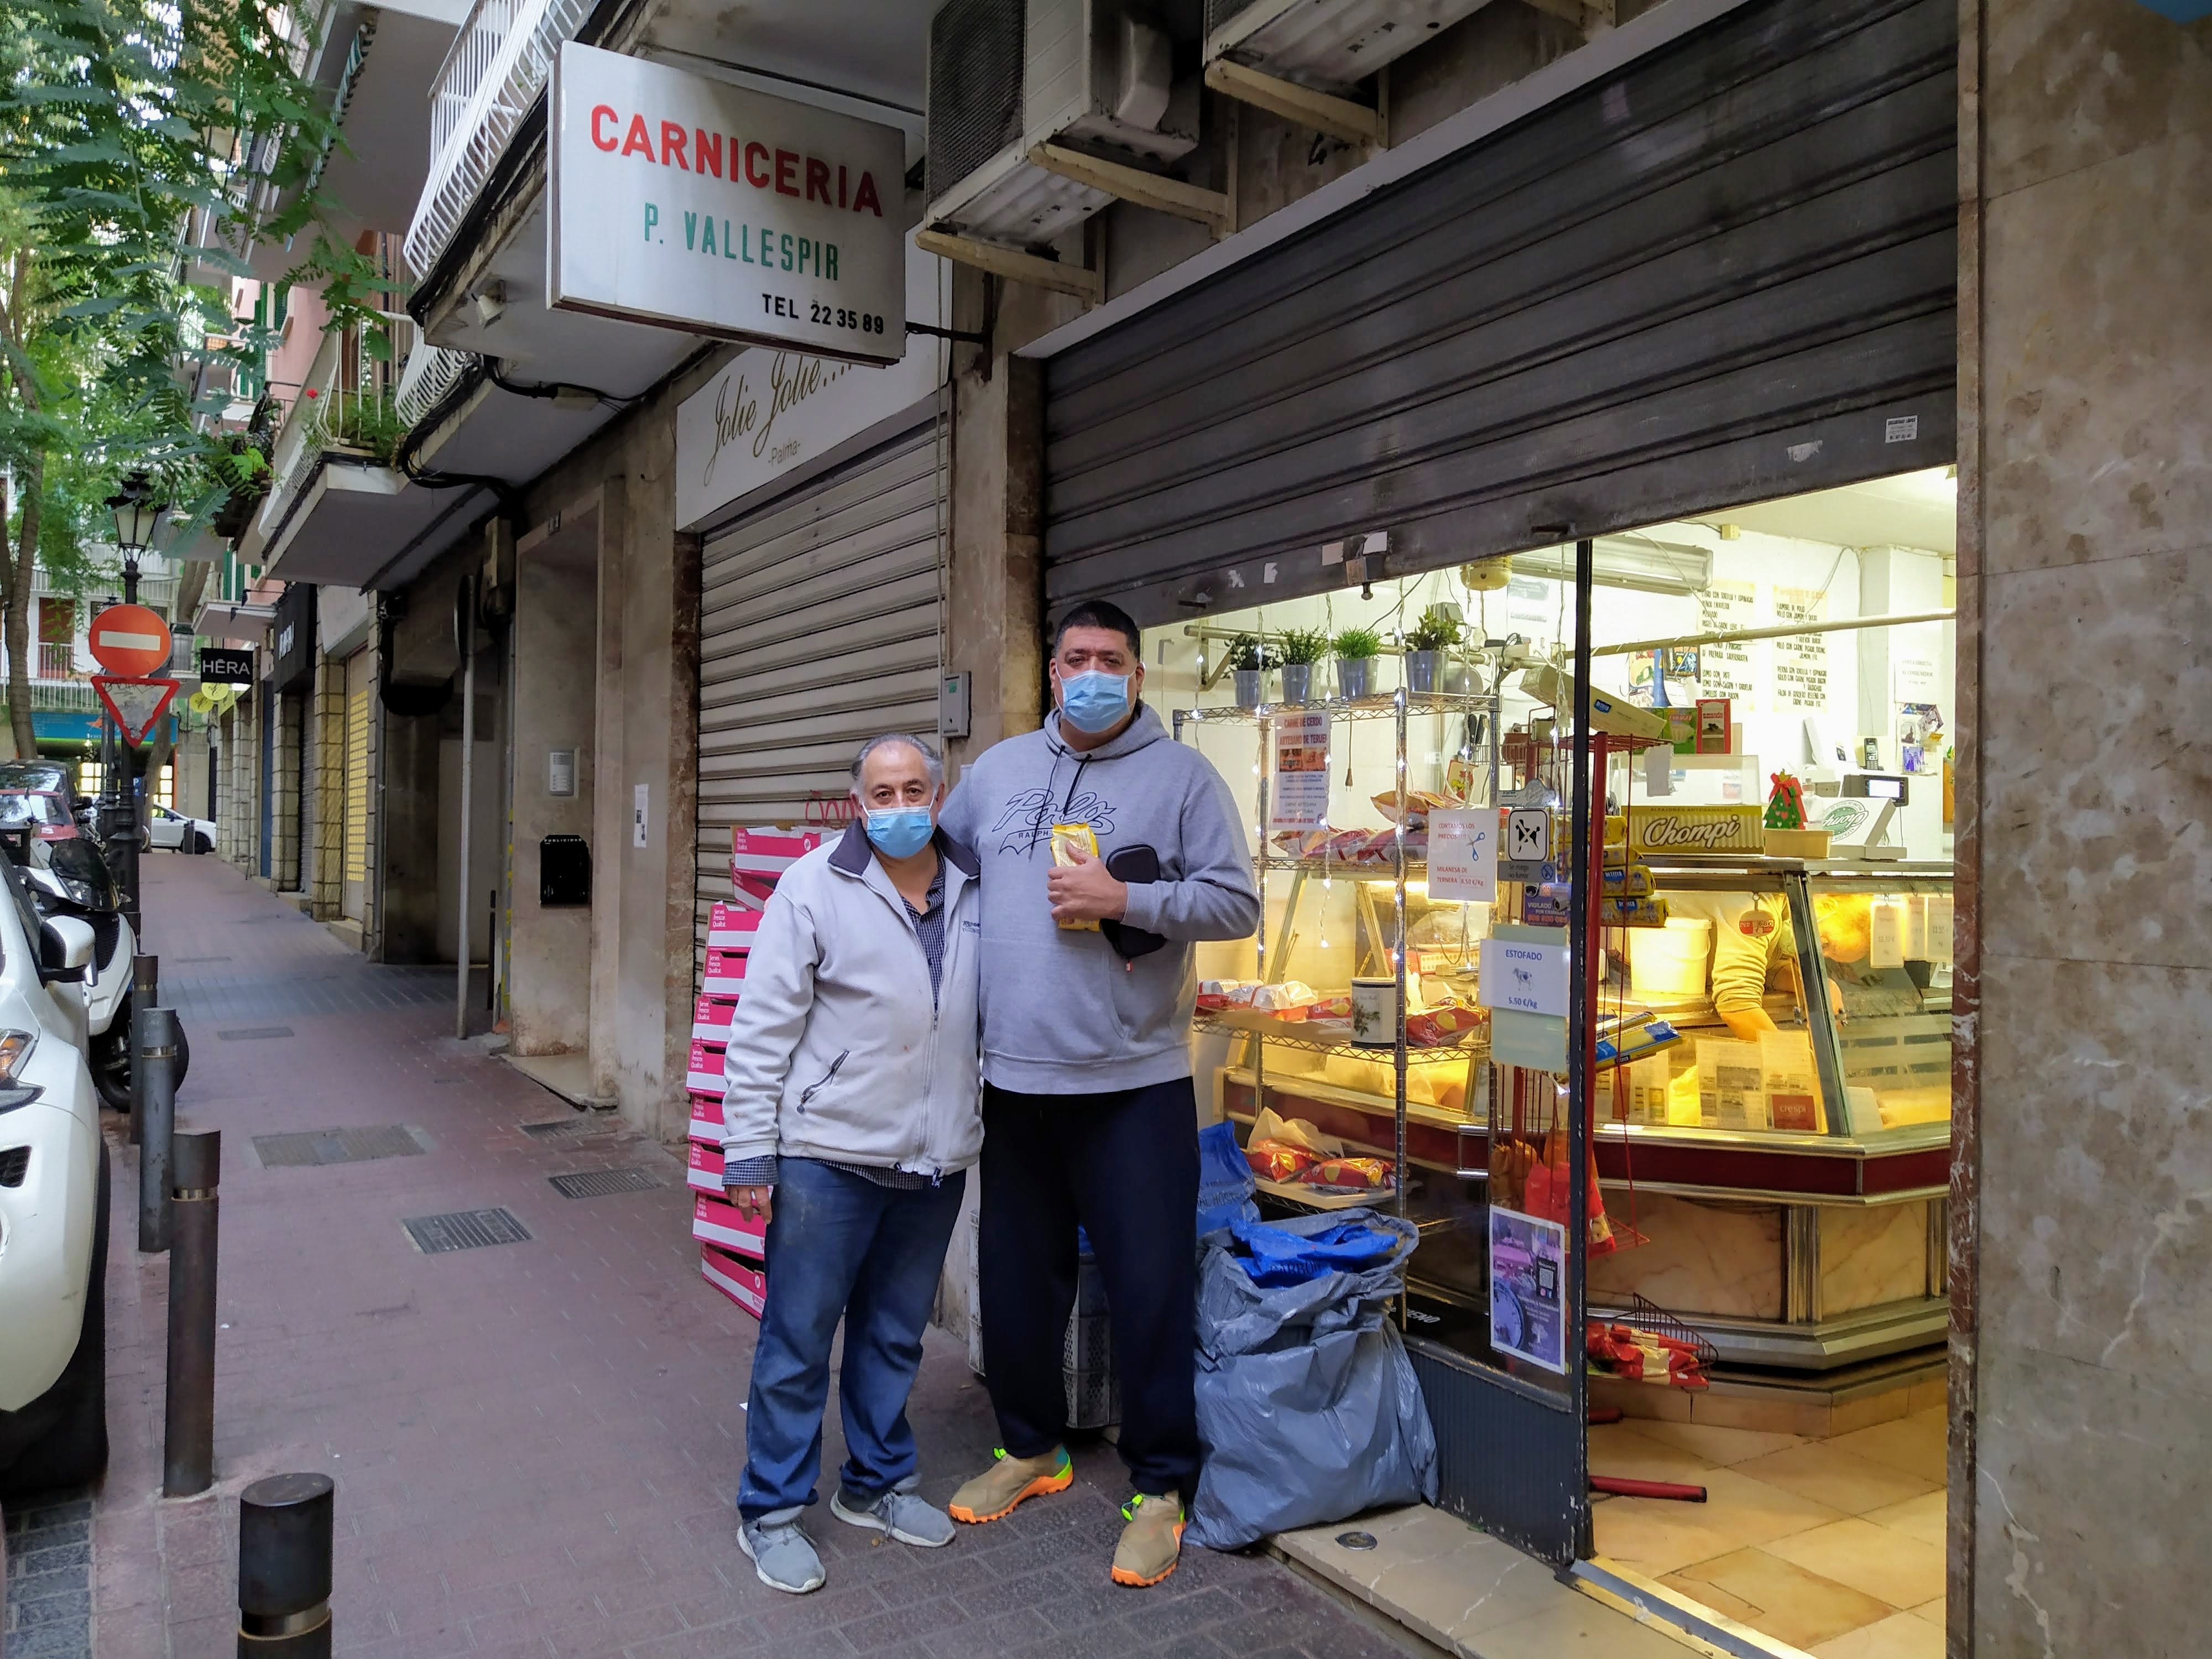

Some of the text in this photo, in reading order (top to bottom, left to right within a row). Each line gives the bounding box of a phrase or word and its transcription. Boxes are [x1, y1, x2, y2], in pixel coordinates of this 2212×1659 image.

[590, 103, 882, 217] CARNICERIA
[644, 201, 838, 281] P. VALLESPIR
[761, 293, 799, 319] TEL
[704, 374, 757, 487] Jolie
[768, 437, 801, 467] -Palma-
[1018, 830, 1049, 839] RALPH
[1643, 814, 1740, 849] Chompi
[1505, 950, 1542, 961] ESTOFADO
[1508, 997, 1537, 1009] 5.50 €/kg
[1780, 1105, 1807, 1114] crespi
